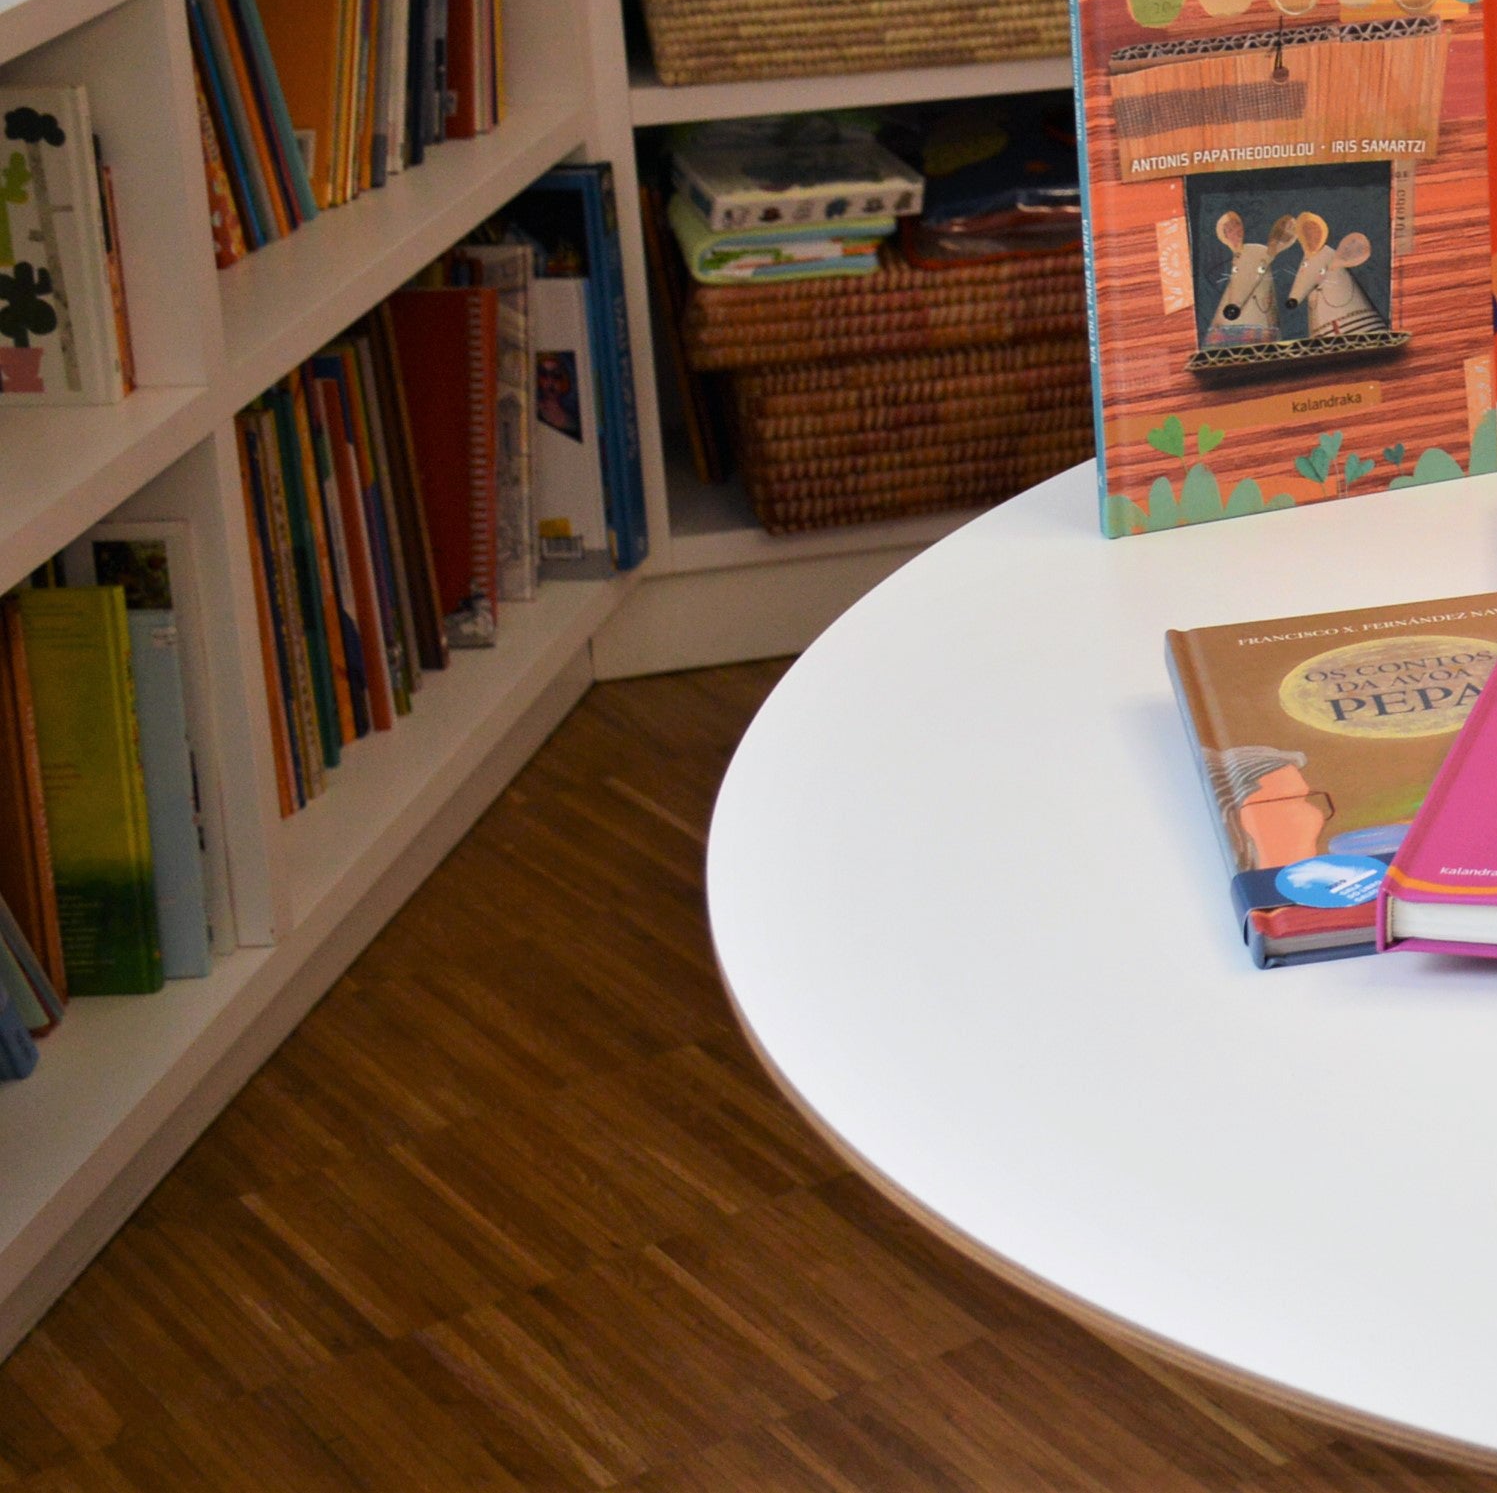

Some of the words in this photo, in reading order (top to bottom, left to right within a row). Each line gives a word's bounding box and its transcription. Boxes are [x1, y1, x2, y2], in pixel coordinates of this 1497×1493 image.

[1132, 154, 1190, 173] ANTONIS
[1193, 142, 1315, 167] PAPATHEODOULOU
[1332, 140, 1357, 154] IRIS
[1361, 139, 1426, 155] SAMARTZI
[1238, 627, 1340, 646] FRANCISCO
[1343, 624, 1359, 634] X.
[1363, 609, 1468, 632] FERNÁNDEZ
[1304, 666, 1351, 684] OS
[1356, 650, 1496, 678] CONTOS
[1333, 678, 1379, 694] DA
[1387, 667, 1473, 689] AVOA
[1325, 682, 1484, 723] PEPA
